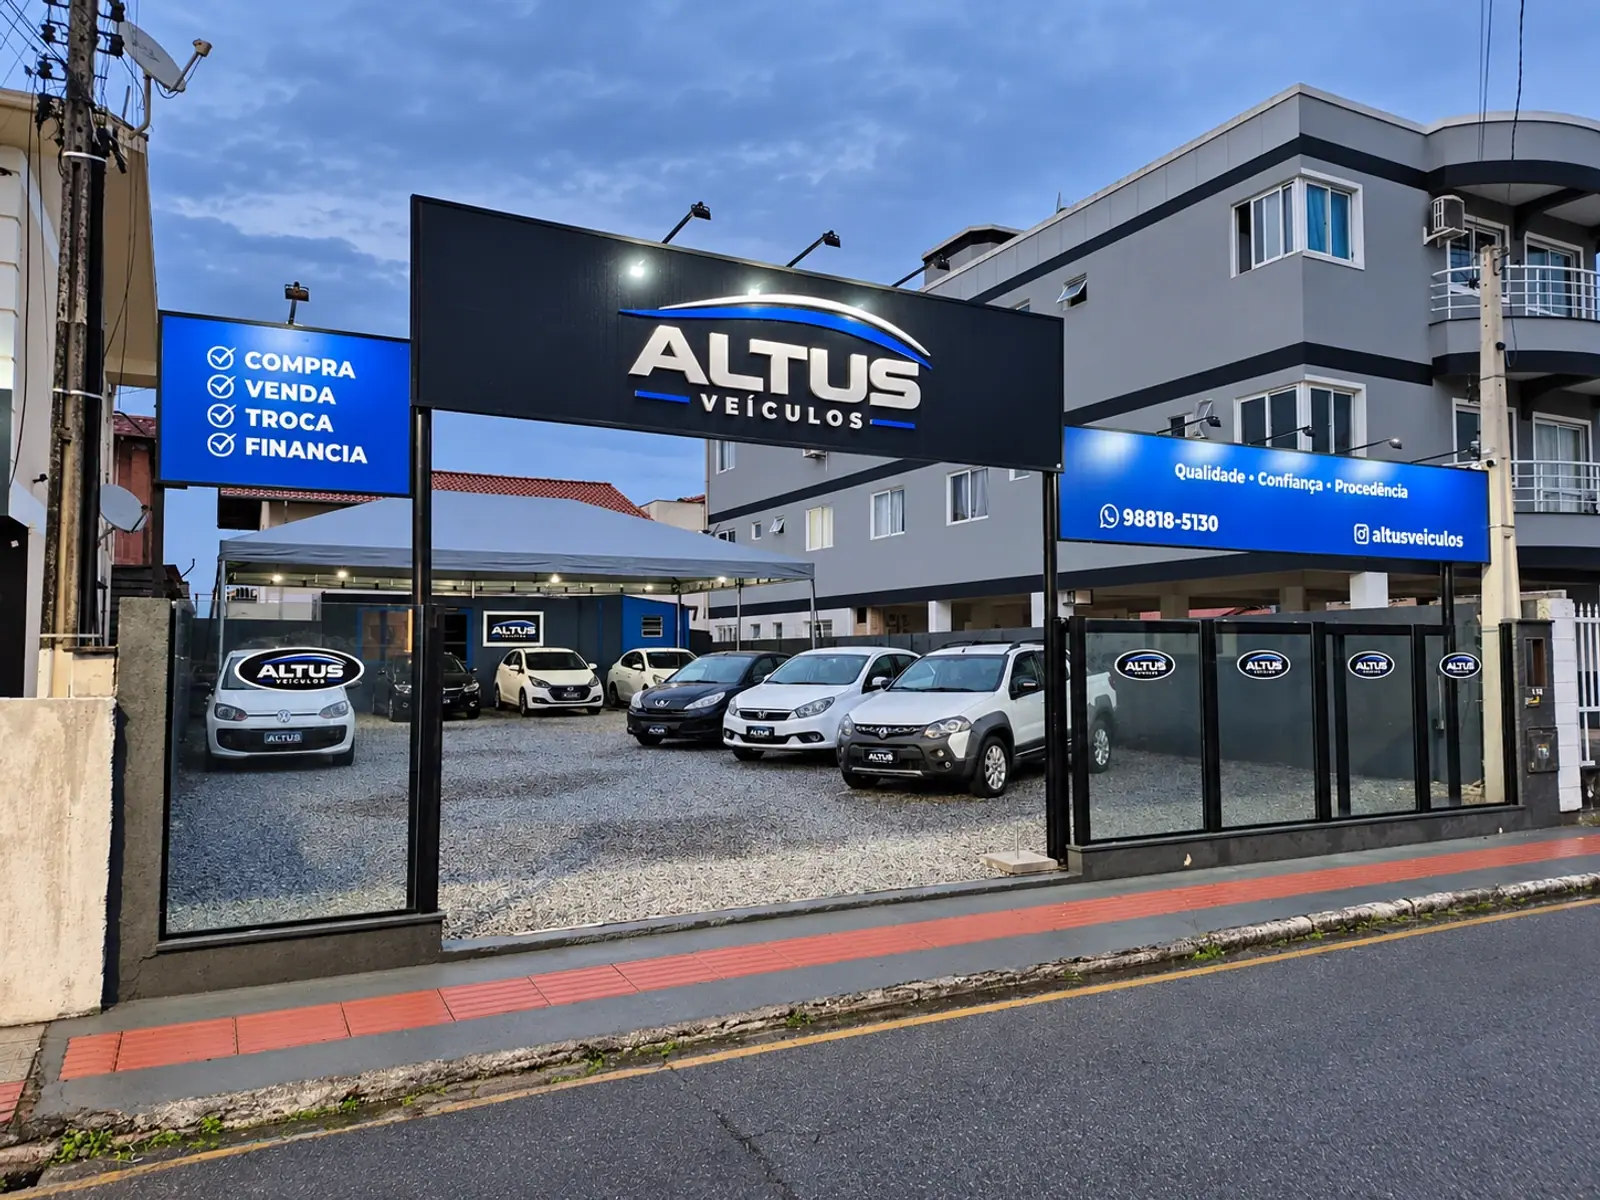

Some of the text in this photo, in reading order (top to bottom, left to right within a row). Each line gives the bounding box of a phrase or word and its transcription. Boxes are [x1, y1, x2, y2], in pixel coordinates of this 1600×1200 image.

[244, 351, 356, 379] COMPRA
[628, 324, 922, 411] ALTUS
[244, 379, 337, 405] VENDA
[245, 407, 334, 432] TROCA
[700, 393, 863, 430] VEÍCULOS
[245, 437, 368, 464] FINANCIA
[1174, 463, 1409, 499] Qualidade Confiança Procedência
[1122, 508, 1219, 532] 98818-5130
[1372, 526, 1464, 548] altusveiculos
[491, 626, 536, 635] ALTUS
[256, 664, 344, 679] ALTUS
[1124, 661, 1167, 671] ALTUS
[1245, 661, 1283, 670] ALTUS
[1355, 661, 1388, 670] ALTUS
[266, 733, 301, 742] ALTUS
